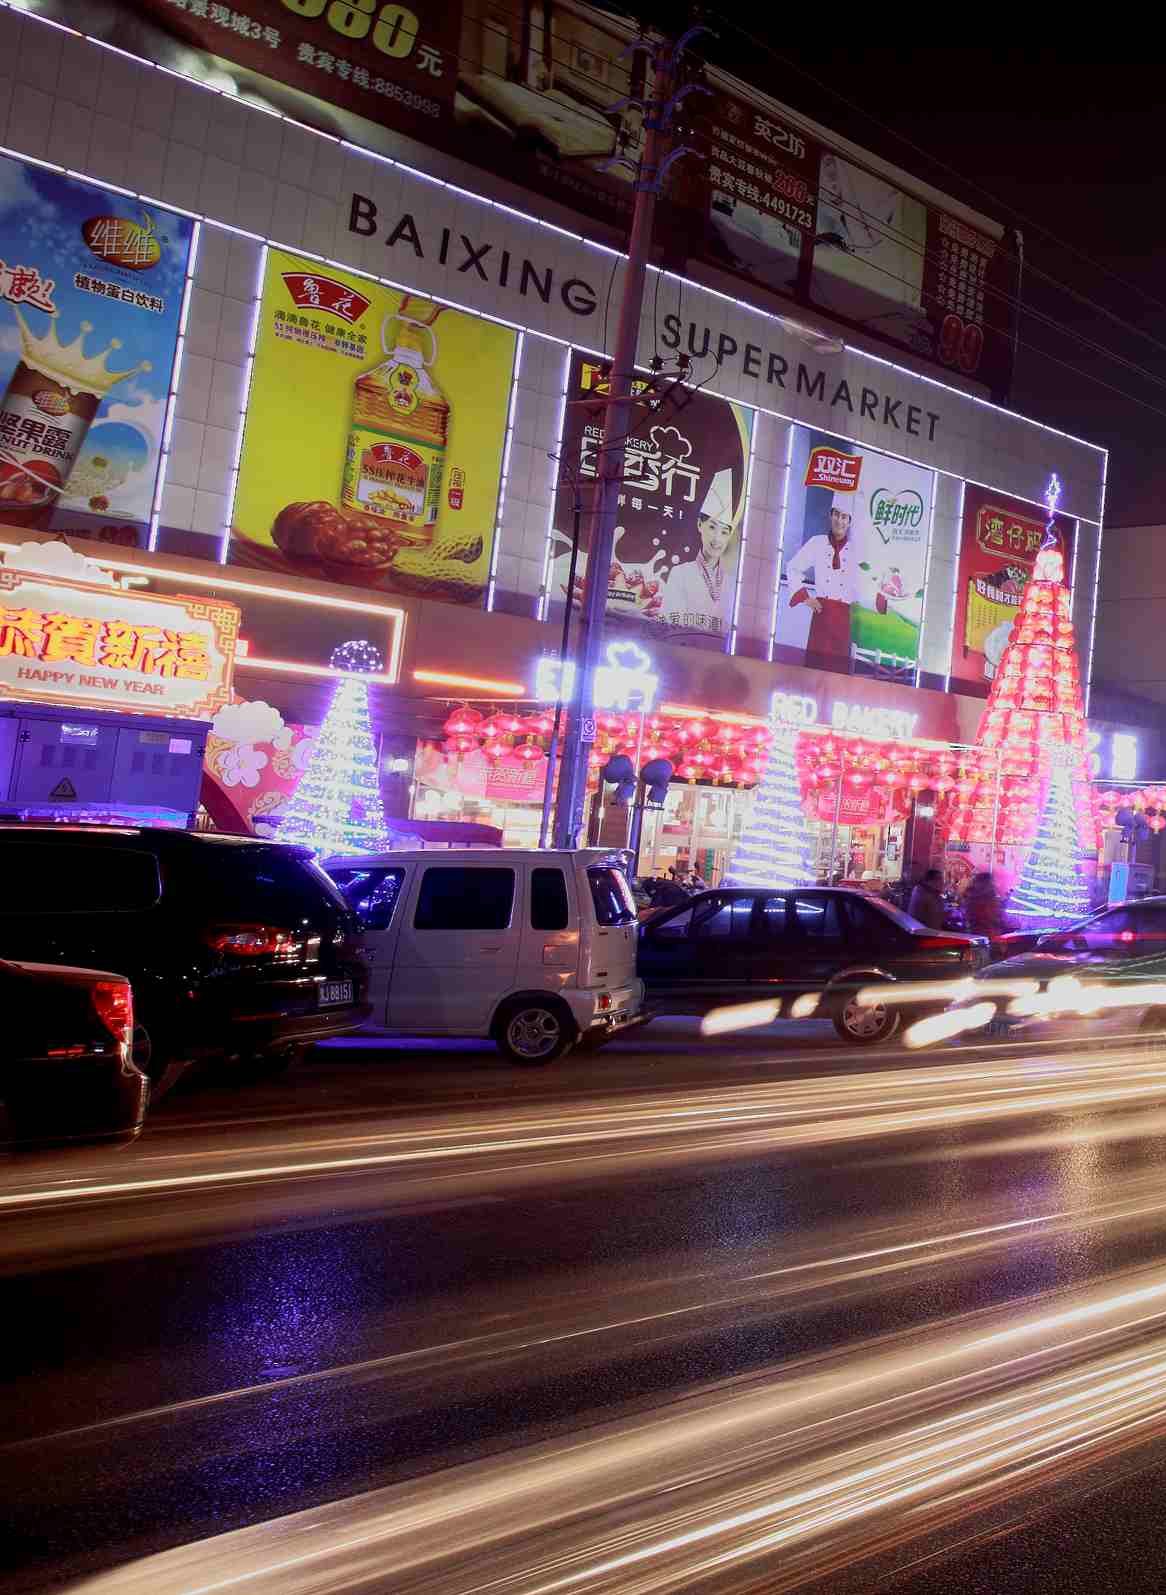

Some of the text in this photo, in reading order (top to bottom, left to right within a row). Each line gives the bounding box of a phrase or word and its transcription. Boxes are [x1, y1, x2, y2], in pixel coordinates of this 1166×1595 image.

[90, 219, 154, 265] 维维
[74, 272, 167, 314] 植物蛋白饮料
[349, 193, 940, 442] BAIXING SUPERMARKET
[31, 440, 75, 461] DRINK
[813, 454, 857, 479] 双汇
[17, 667, 168, 696] HAPPY NEW YEAR
